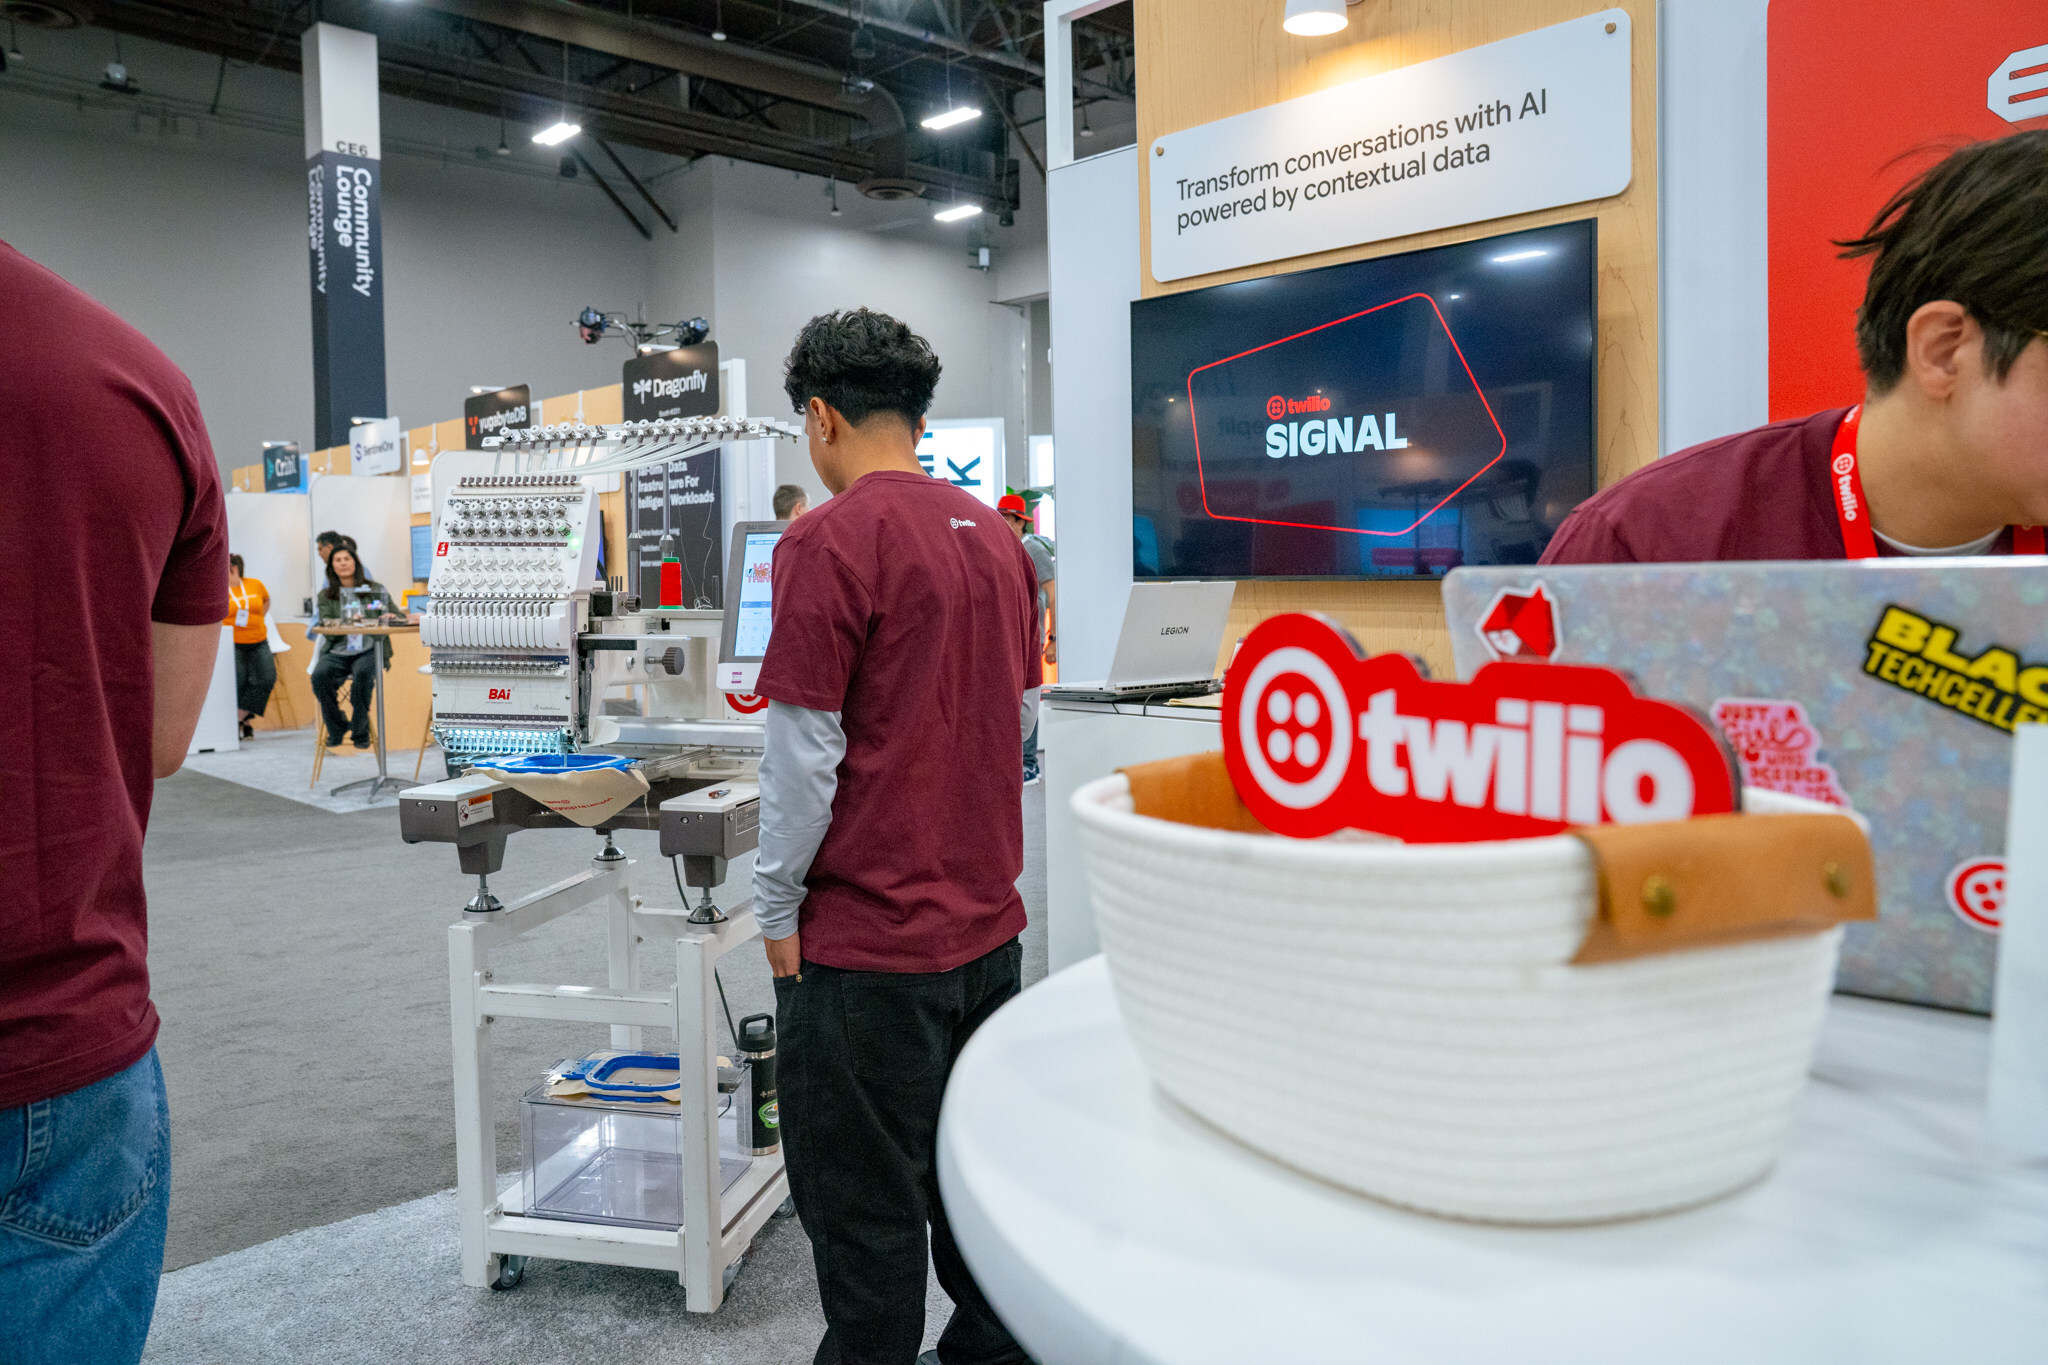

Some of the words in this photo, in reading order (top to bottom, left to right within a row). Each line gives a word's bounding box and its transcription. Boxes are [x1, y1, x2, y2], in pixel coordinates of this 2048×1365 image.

[336, 140, 369, 158] CE6
[1177, 162, 1279, 200] Transform
[1285, 120, 1449, 175] conversations
[1454, 100, 1511, 134] with
[1518, 88, 1547, 120] AI
[333, 164, 354, 248] Lounge
[1177, 188, 1267, 236] powered
[1273, 185, 1299, 212] by
[1304, 151, 1426, 201] contextual
[1433, 139, 1490, 172] data
[353, 167, 374, 298] Community
[652, 369, 708, 398] Dragonfly
[1287, 395, 1331, 414] twilio
[1265, 412, 1408, 459] SIGNAL
[1838, 474, 1859, 522] twilio
[1160, 626, 1190, 636] LEGION
[488, 688, 512, 701] BAi
[1864, 641, 2048, 733] TECHCELLE
[1358, 687, 1696, 827] twilio
